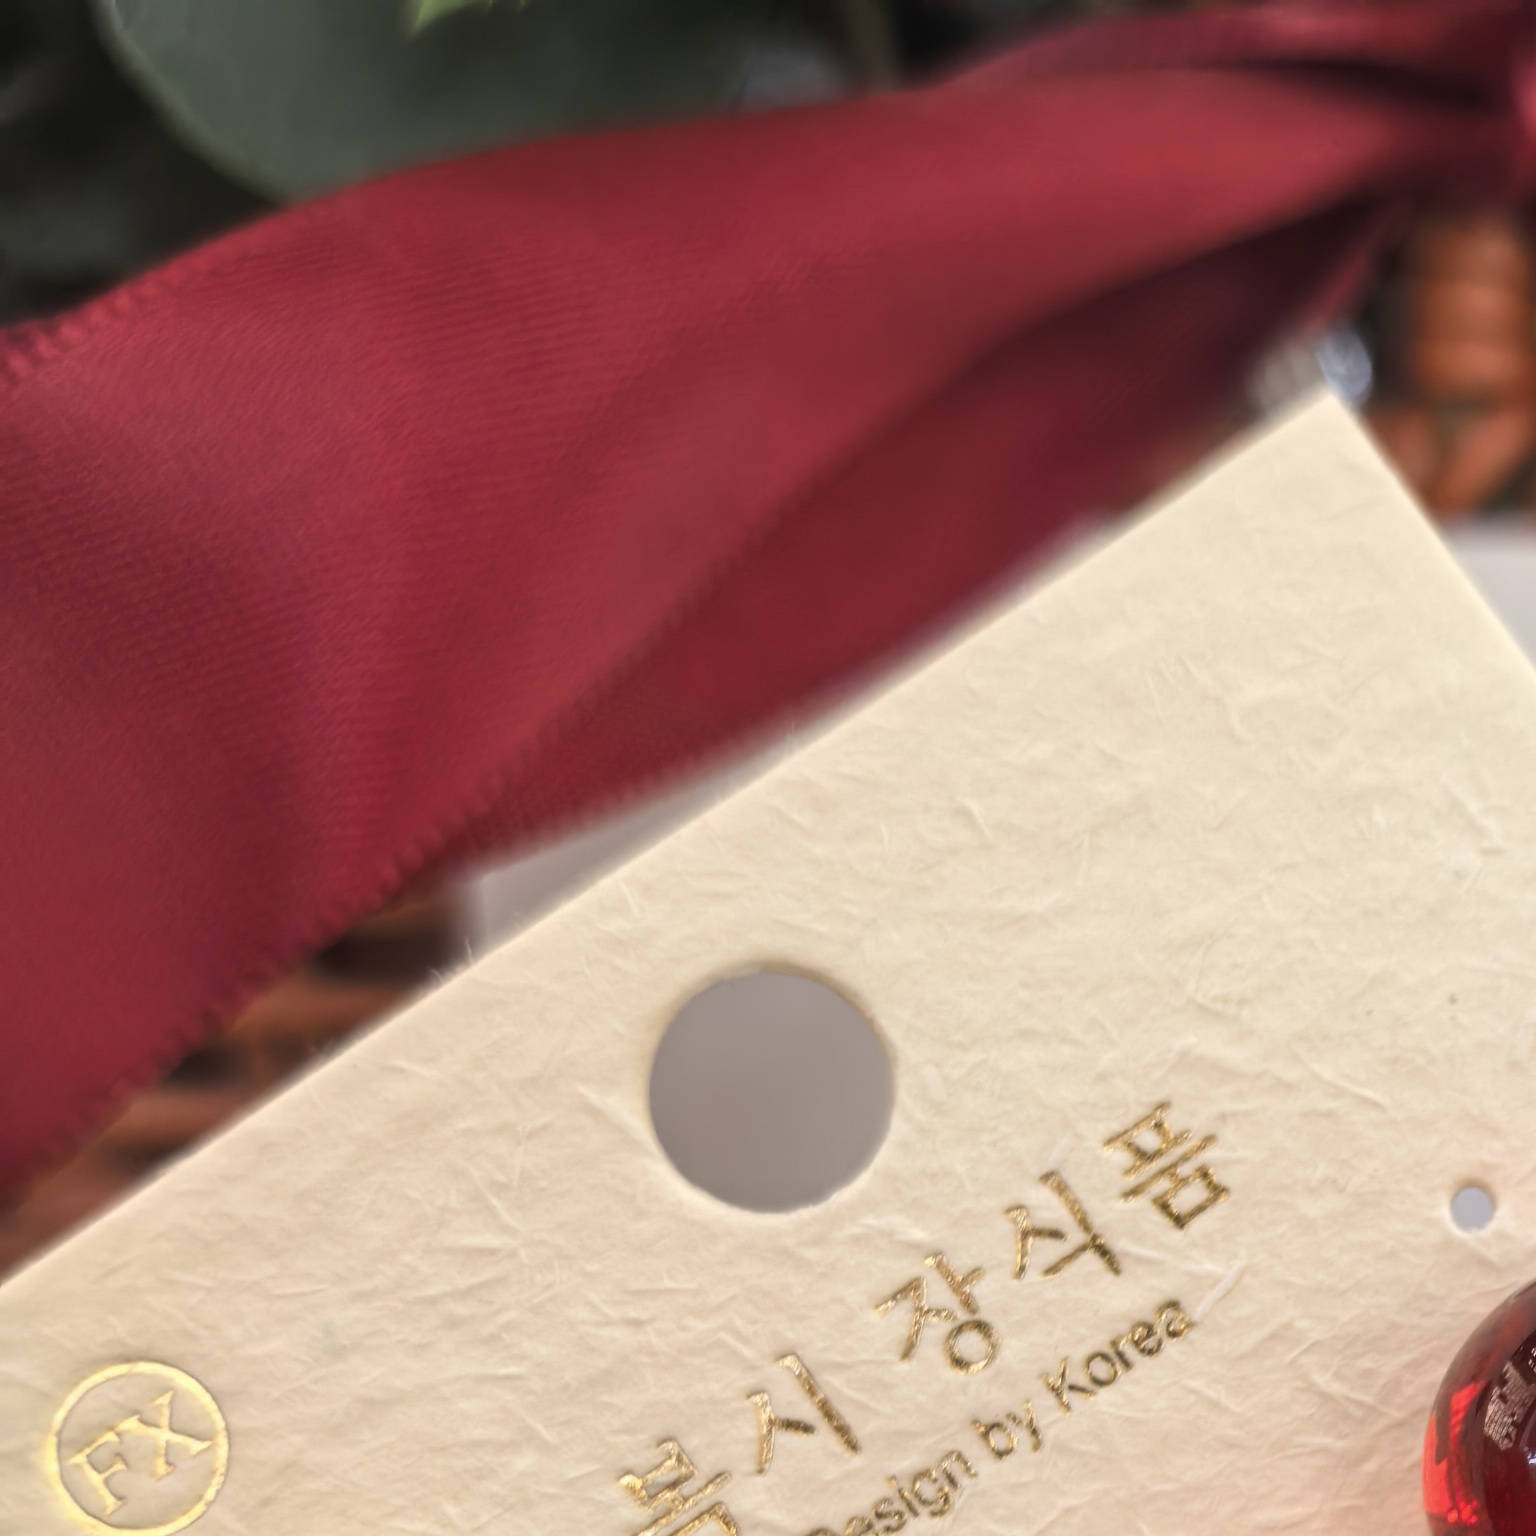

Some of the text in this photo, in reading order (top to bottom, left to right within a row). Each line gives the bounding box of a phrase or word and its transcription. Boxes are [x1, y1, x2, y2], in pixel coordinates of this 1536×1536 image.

[873, 1101, 1231, 1374] 장식품
[66, 1389, 215, 1515] FX
[970, 1400, 1043, 1460] by
[1041, 1300, 1197, 1417] Korea
